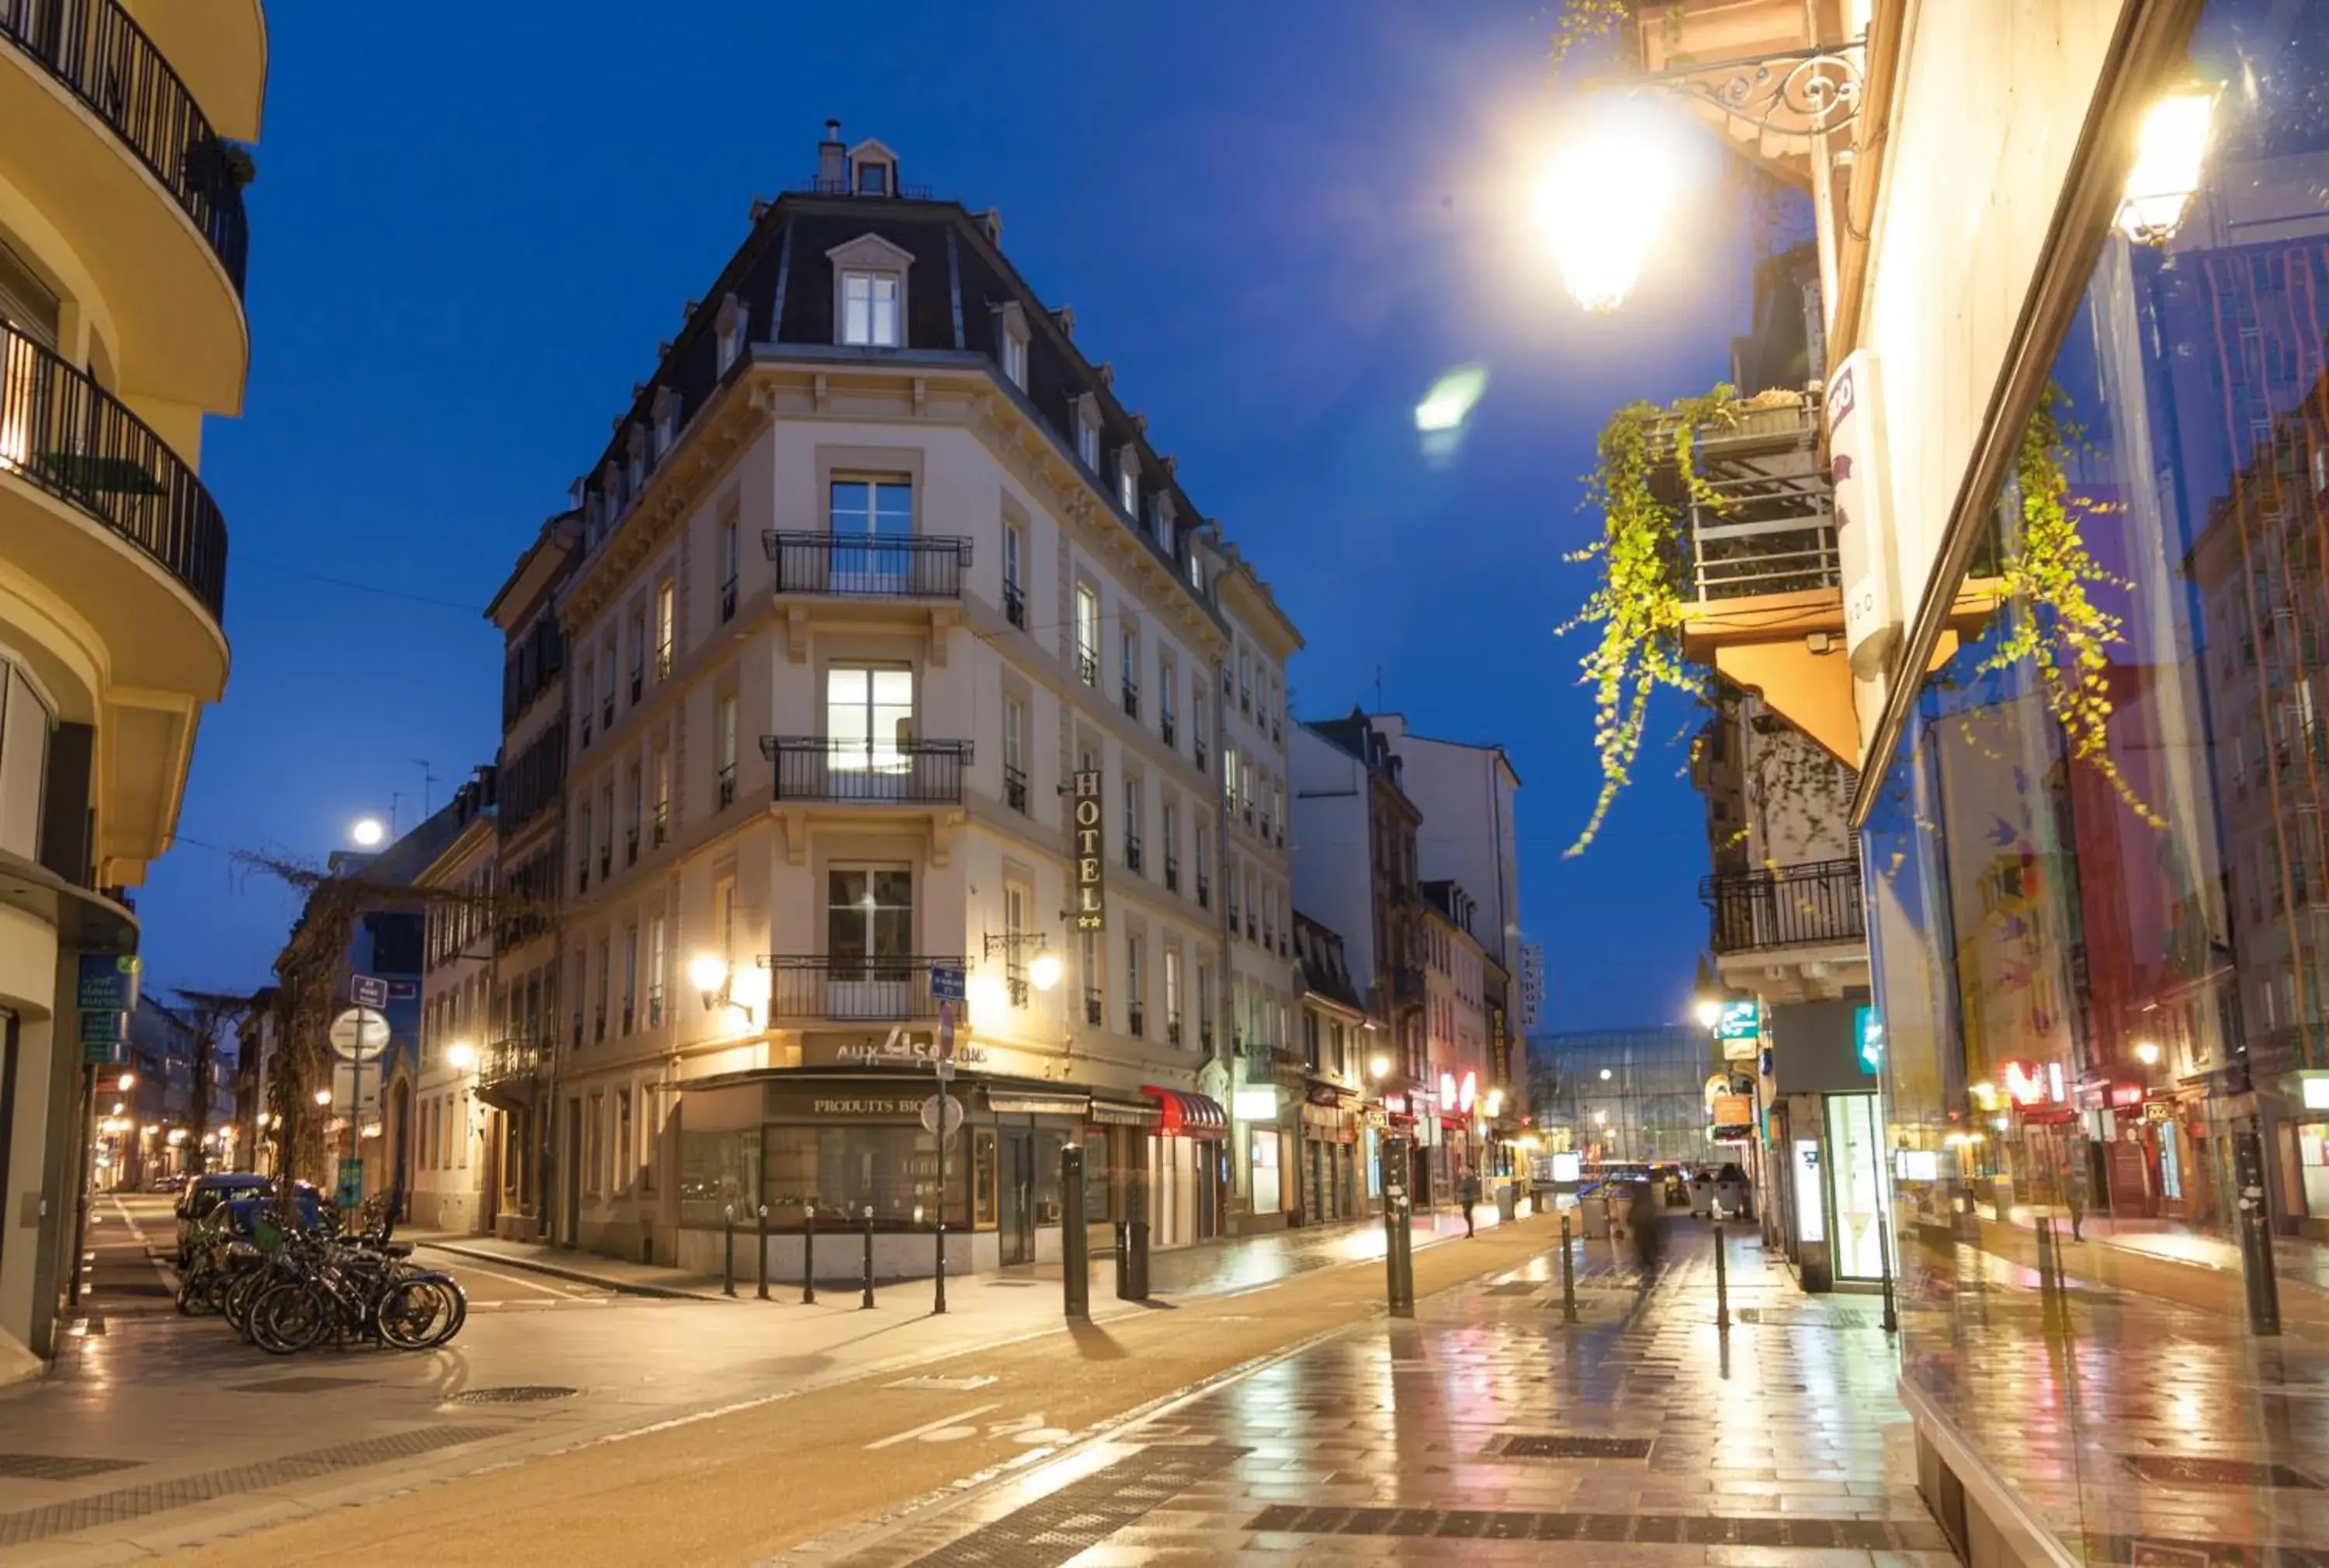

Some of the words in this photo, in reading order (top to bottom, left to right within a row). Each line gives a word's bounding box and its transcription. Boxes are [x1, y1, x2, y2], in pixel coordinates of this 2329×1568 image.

[1075, 772, 1102, 912] HOTEL
[836, 1045, 880, 1061] AUX
[884, 1025, 911, 1058] 4
[814, 1099, 894, 1113] PRODUITS
